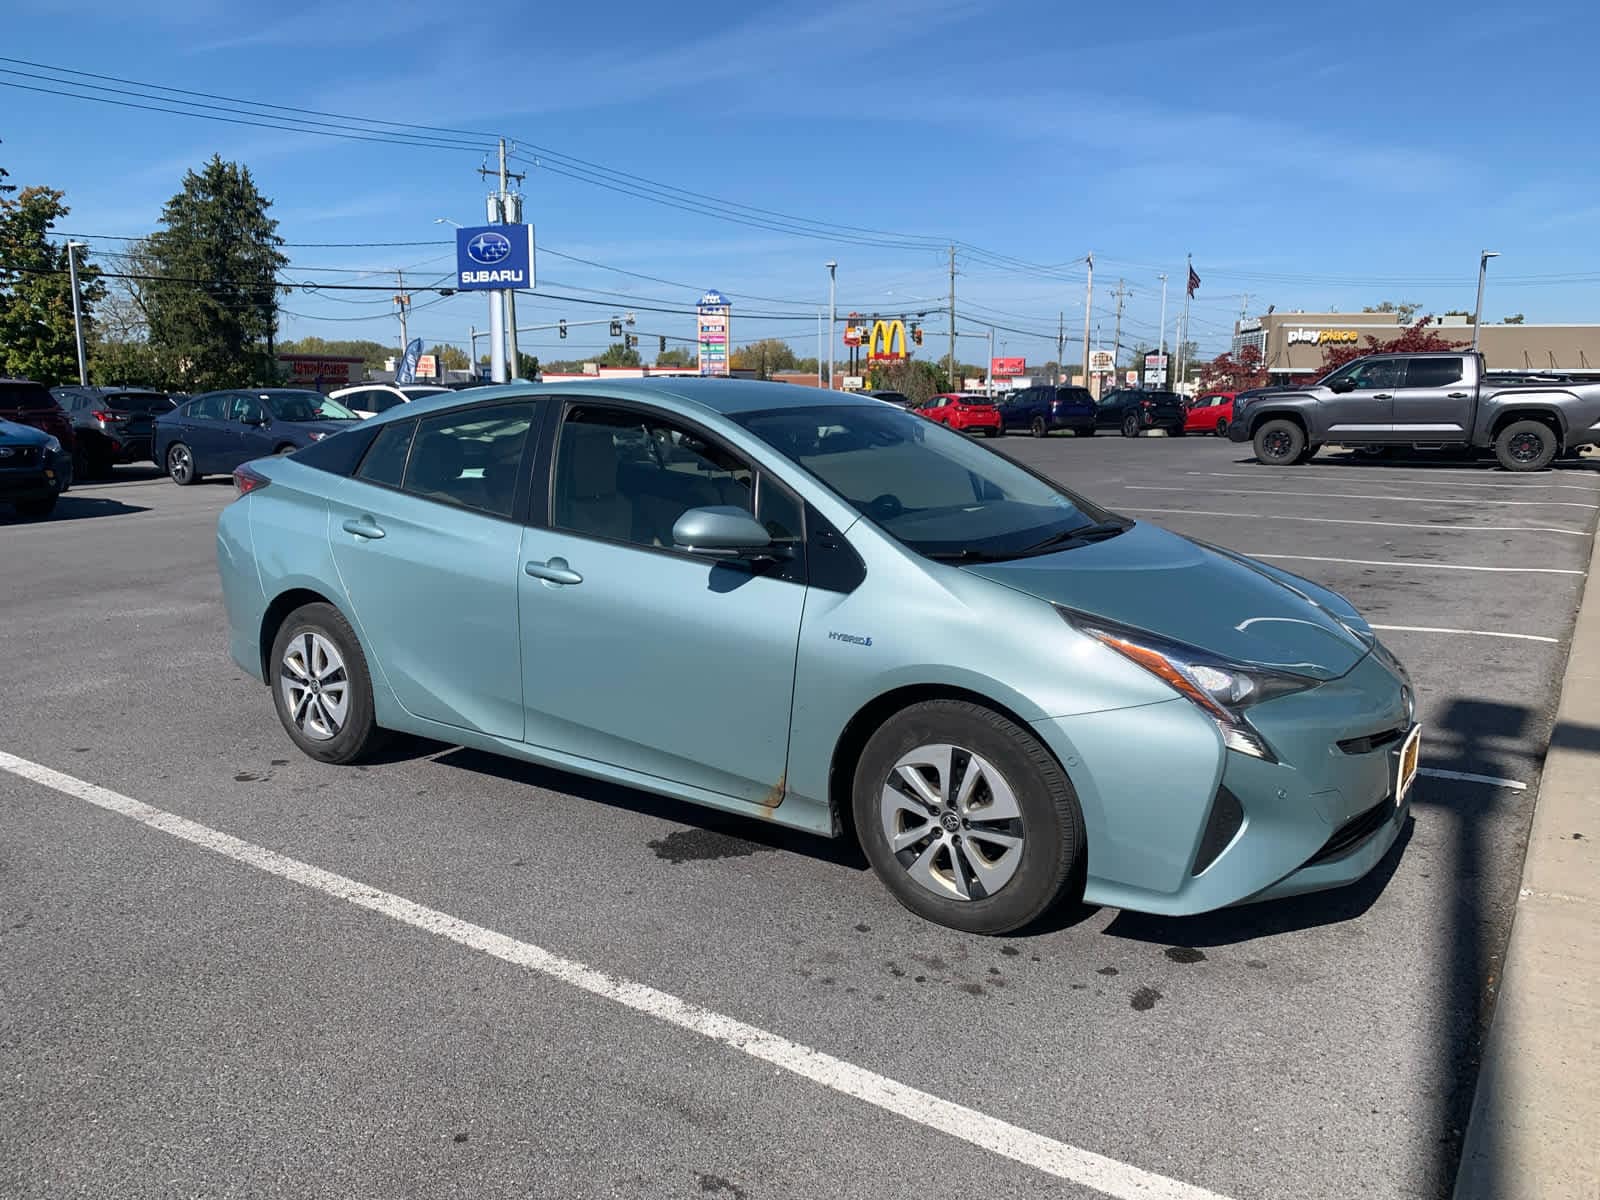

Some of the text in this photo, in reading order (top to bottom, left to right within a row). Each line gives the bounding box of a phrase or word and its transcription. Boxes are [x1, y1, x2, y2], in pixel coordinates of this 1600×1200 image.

[461, 269, 523, 283] SUBARU
[1287, 328, 1358, 344] playplace
[828, 631, 865, 646] HYBRID
